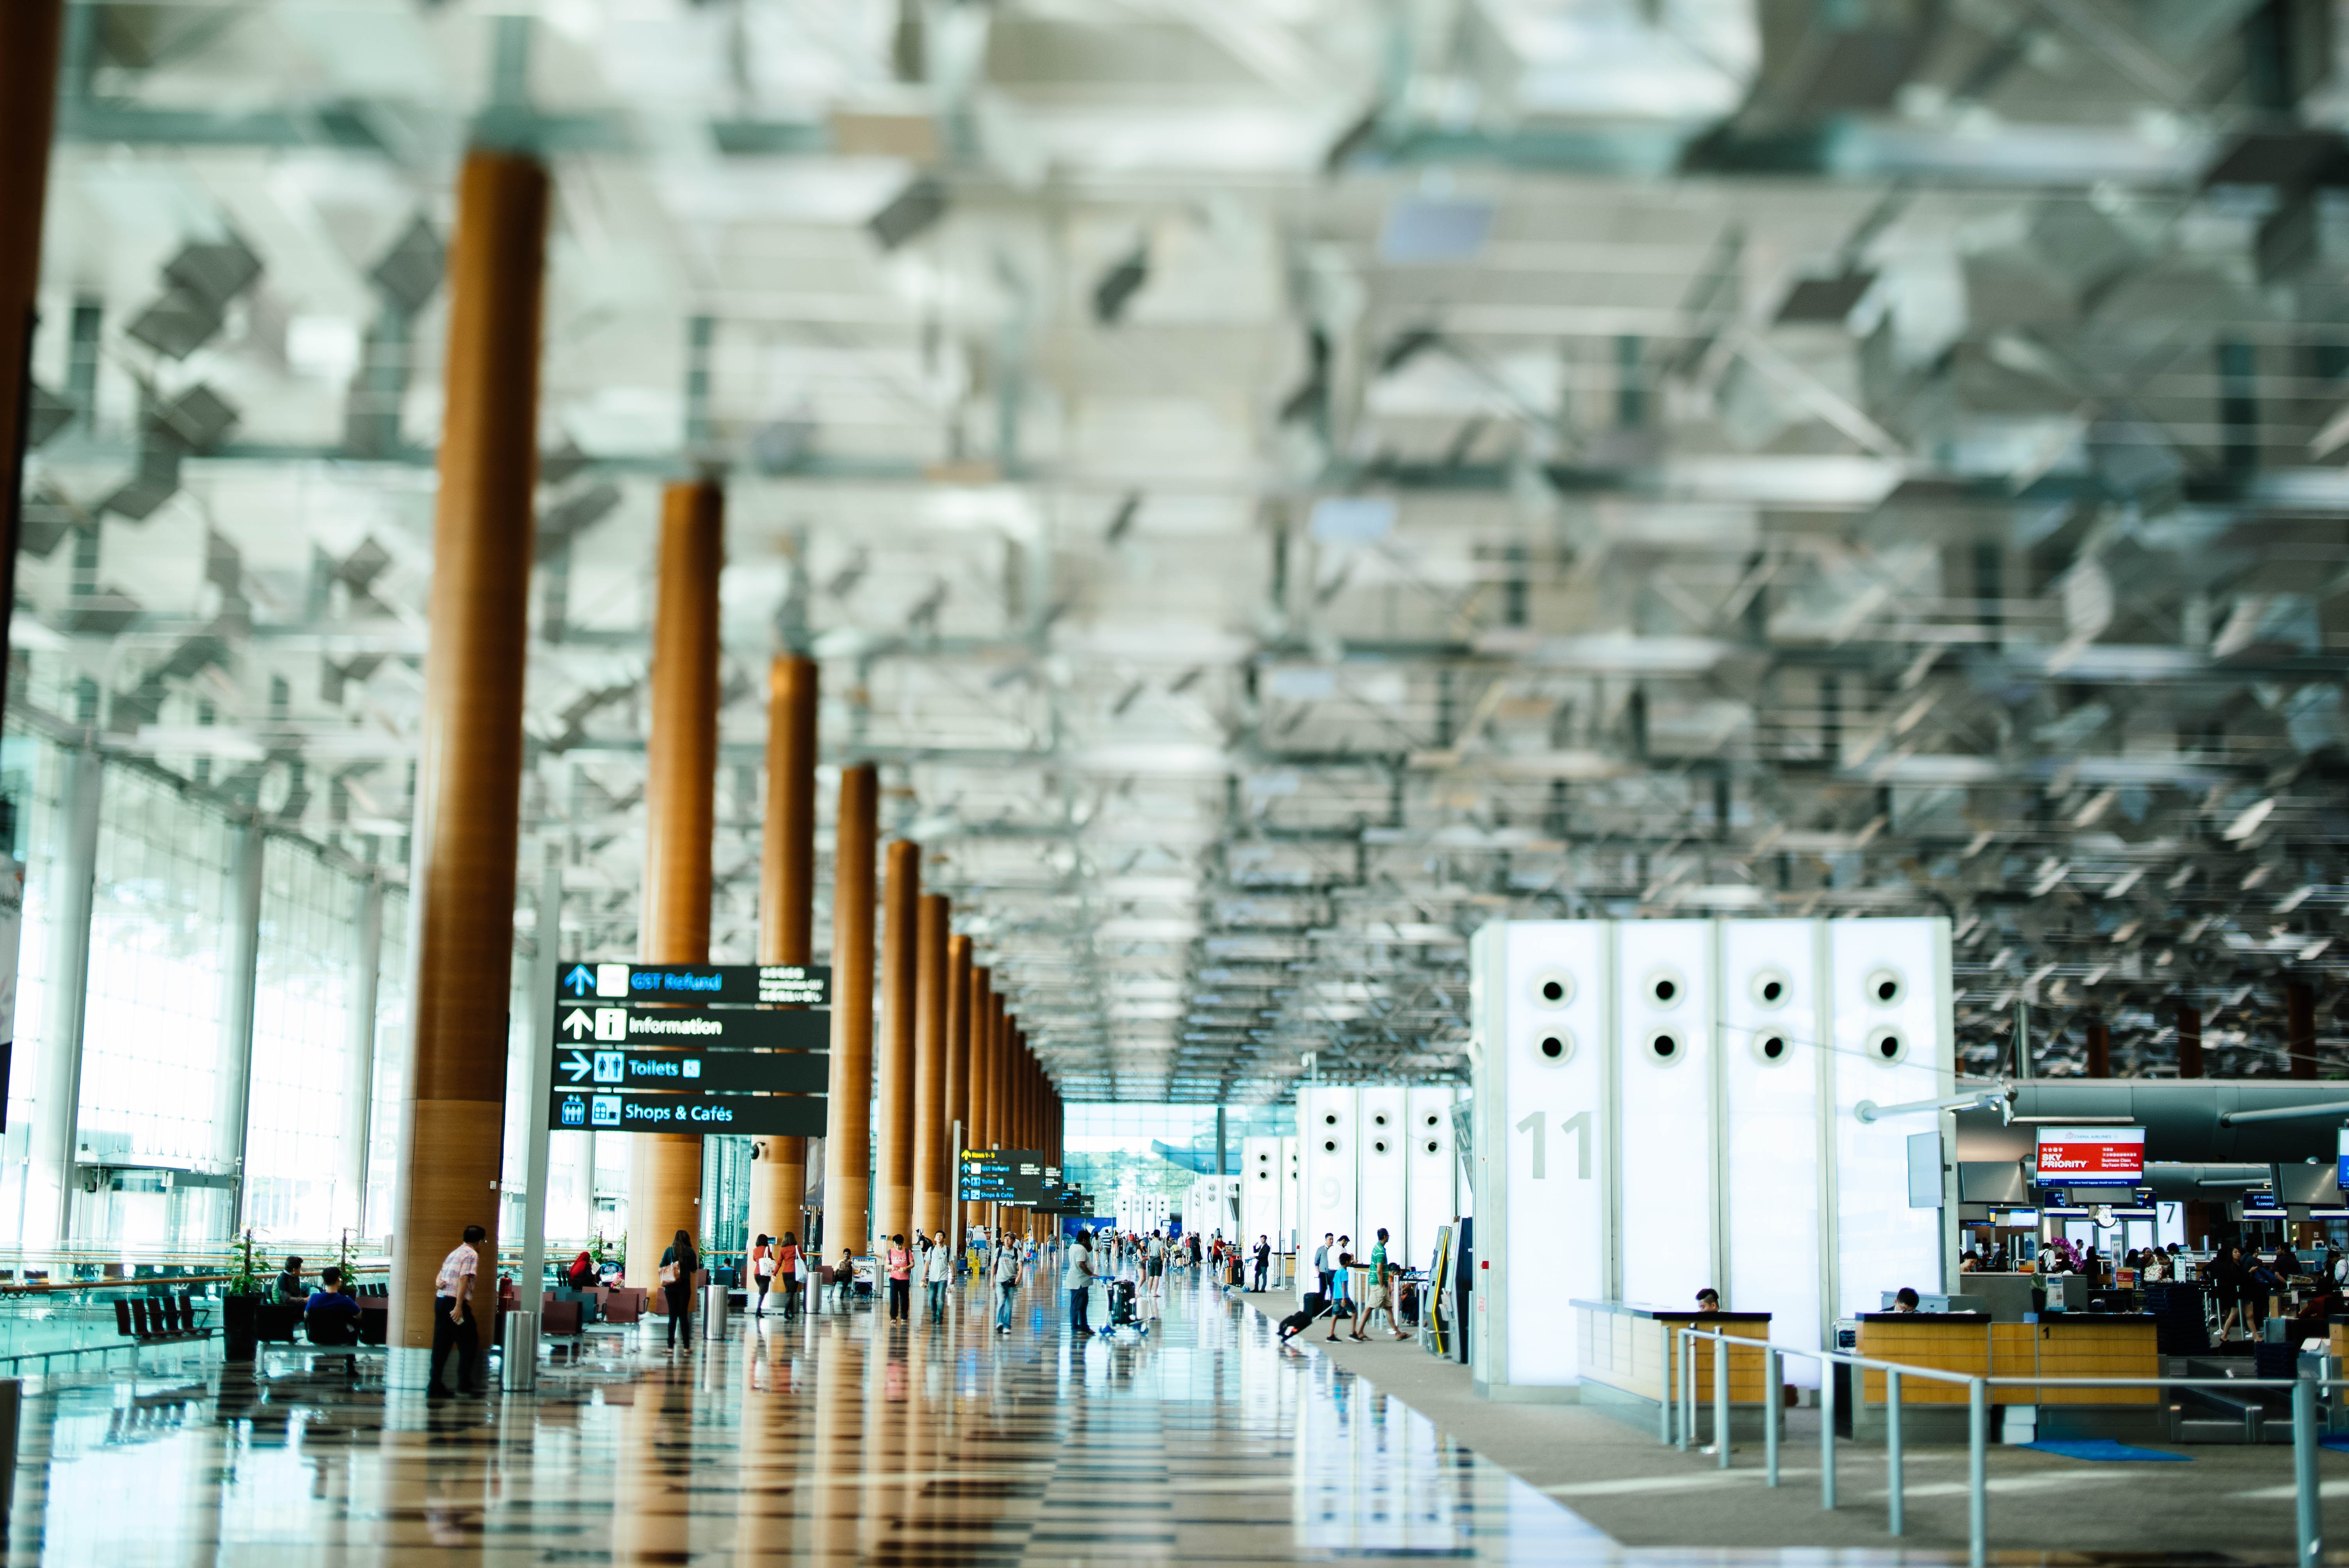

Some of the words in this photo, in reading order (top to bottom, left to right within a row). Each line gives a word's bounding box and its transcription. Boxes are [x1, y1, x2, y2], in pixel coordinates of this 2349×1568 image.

[631, 973, 663, 990] GST
[665, 972, 722, 991] Refund
[629, 1016, 722, 1035] Information
[628, 1060, 679, 1076] Toilets
[625, 1103, 671, 1123] Shops
[675, 1105, 687, 1120] &
[691, 1105, 733, 1121] Cafés
[1516, 1112, 1591, 1180] 11
[2164, 1203, 2175, 1224] 7
